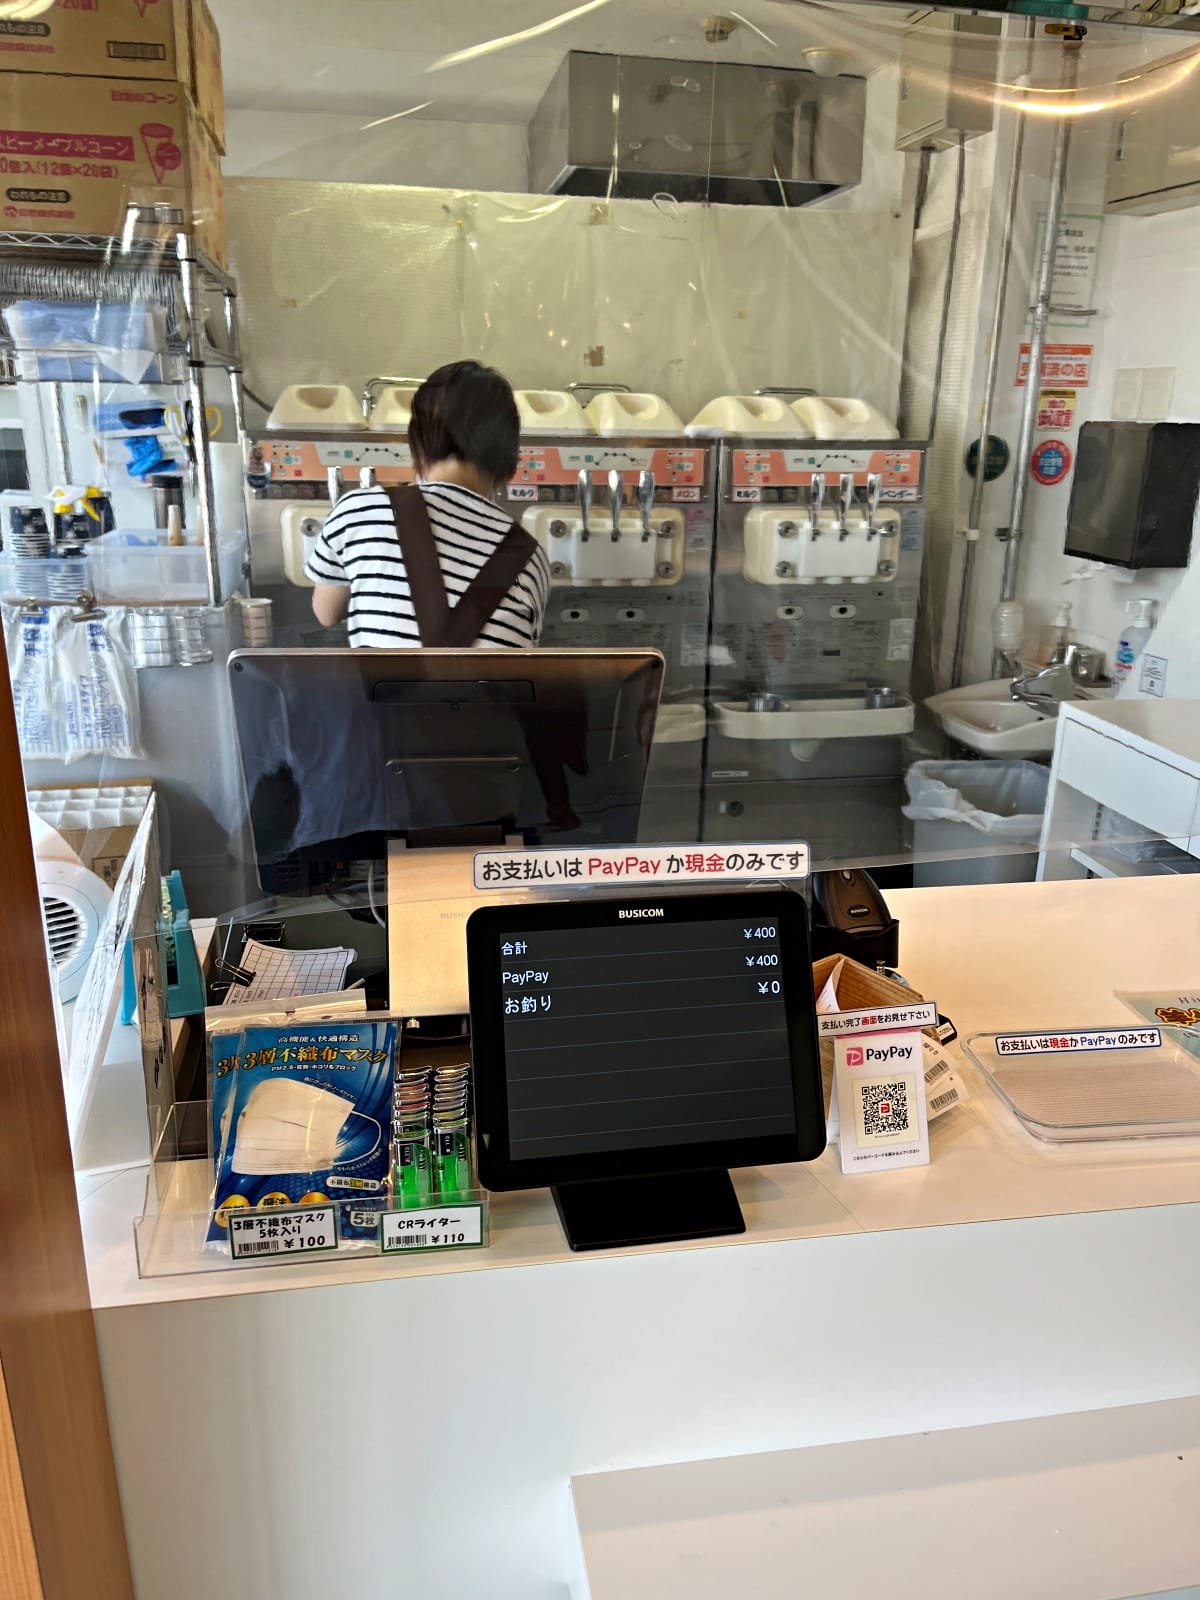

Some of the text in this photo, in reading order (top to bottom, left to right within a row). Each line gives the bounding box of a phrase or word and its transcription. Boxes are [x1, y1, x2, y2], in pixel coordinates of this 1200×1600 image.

[482, 851, 804, 881] お支払いは PayPay か現金のみです
[618, 908, 664, 919] BUSICOM
[501, 940, 528, 956] 合計
[502, 970, 549, 986] PayPay
[504, 994, 552, 1015] お釣り
[821, 1010, 931, 1031] 支払い完了画面をお見せ下さい
[1000, 1032, 1157, 1052] お支払いは現金か PayPay のみです
[243, 1046, 389, 1071] 3層不織布マスク
[866, 1046, 913, 1062] PayPay
[233, 1212, 325, 1231] 3層不織布マスク
[397, 1217, 461, 1230] CRライター
[259, 1225, 301, 1239] 5枚入り
